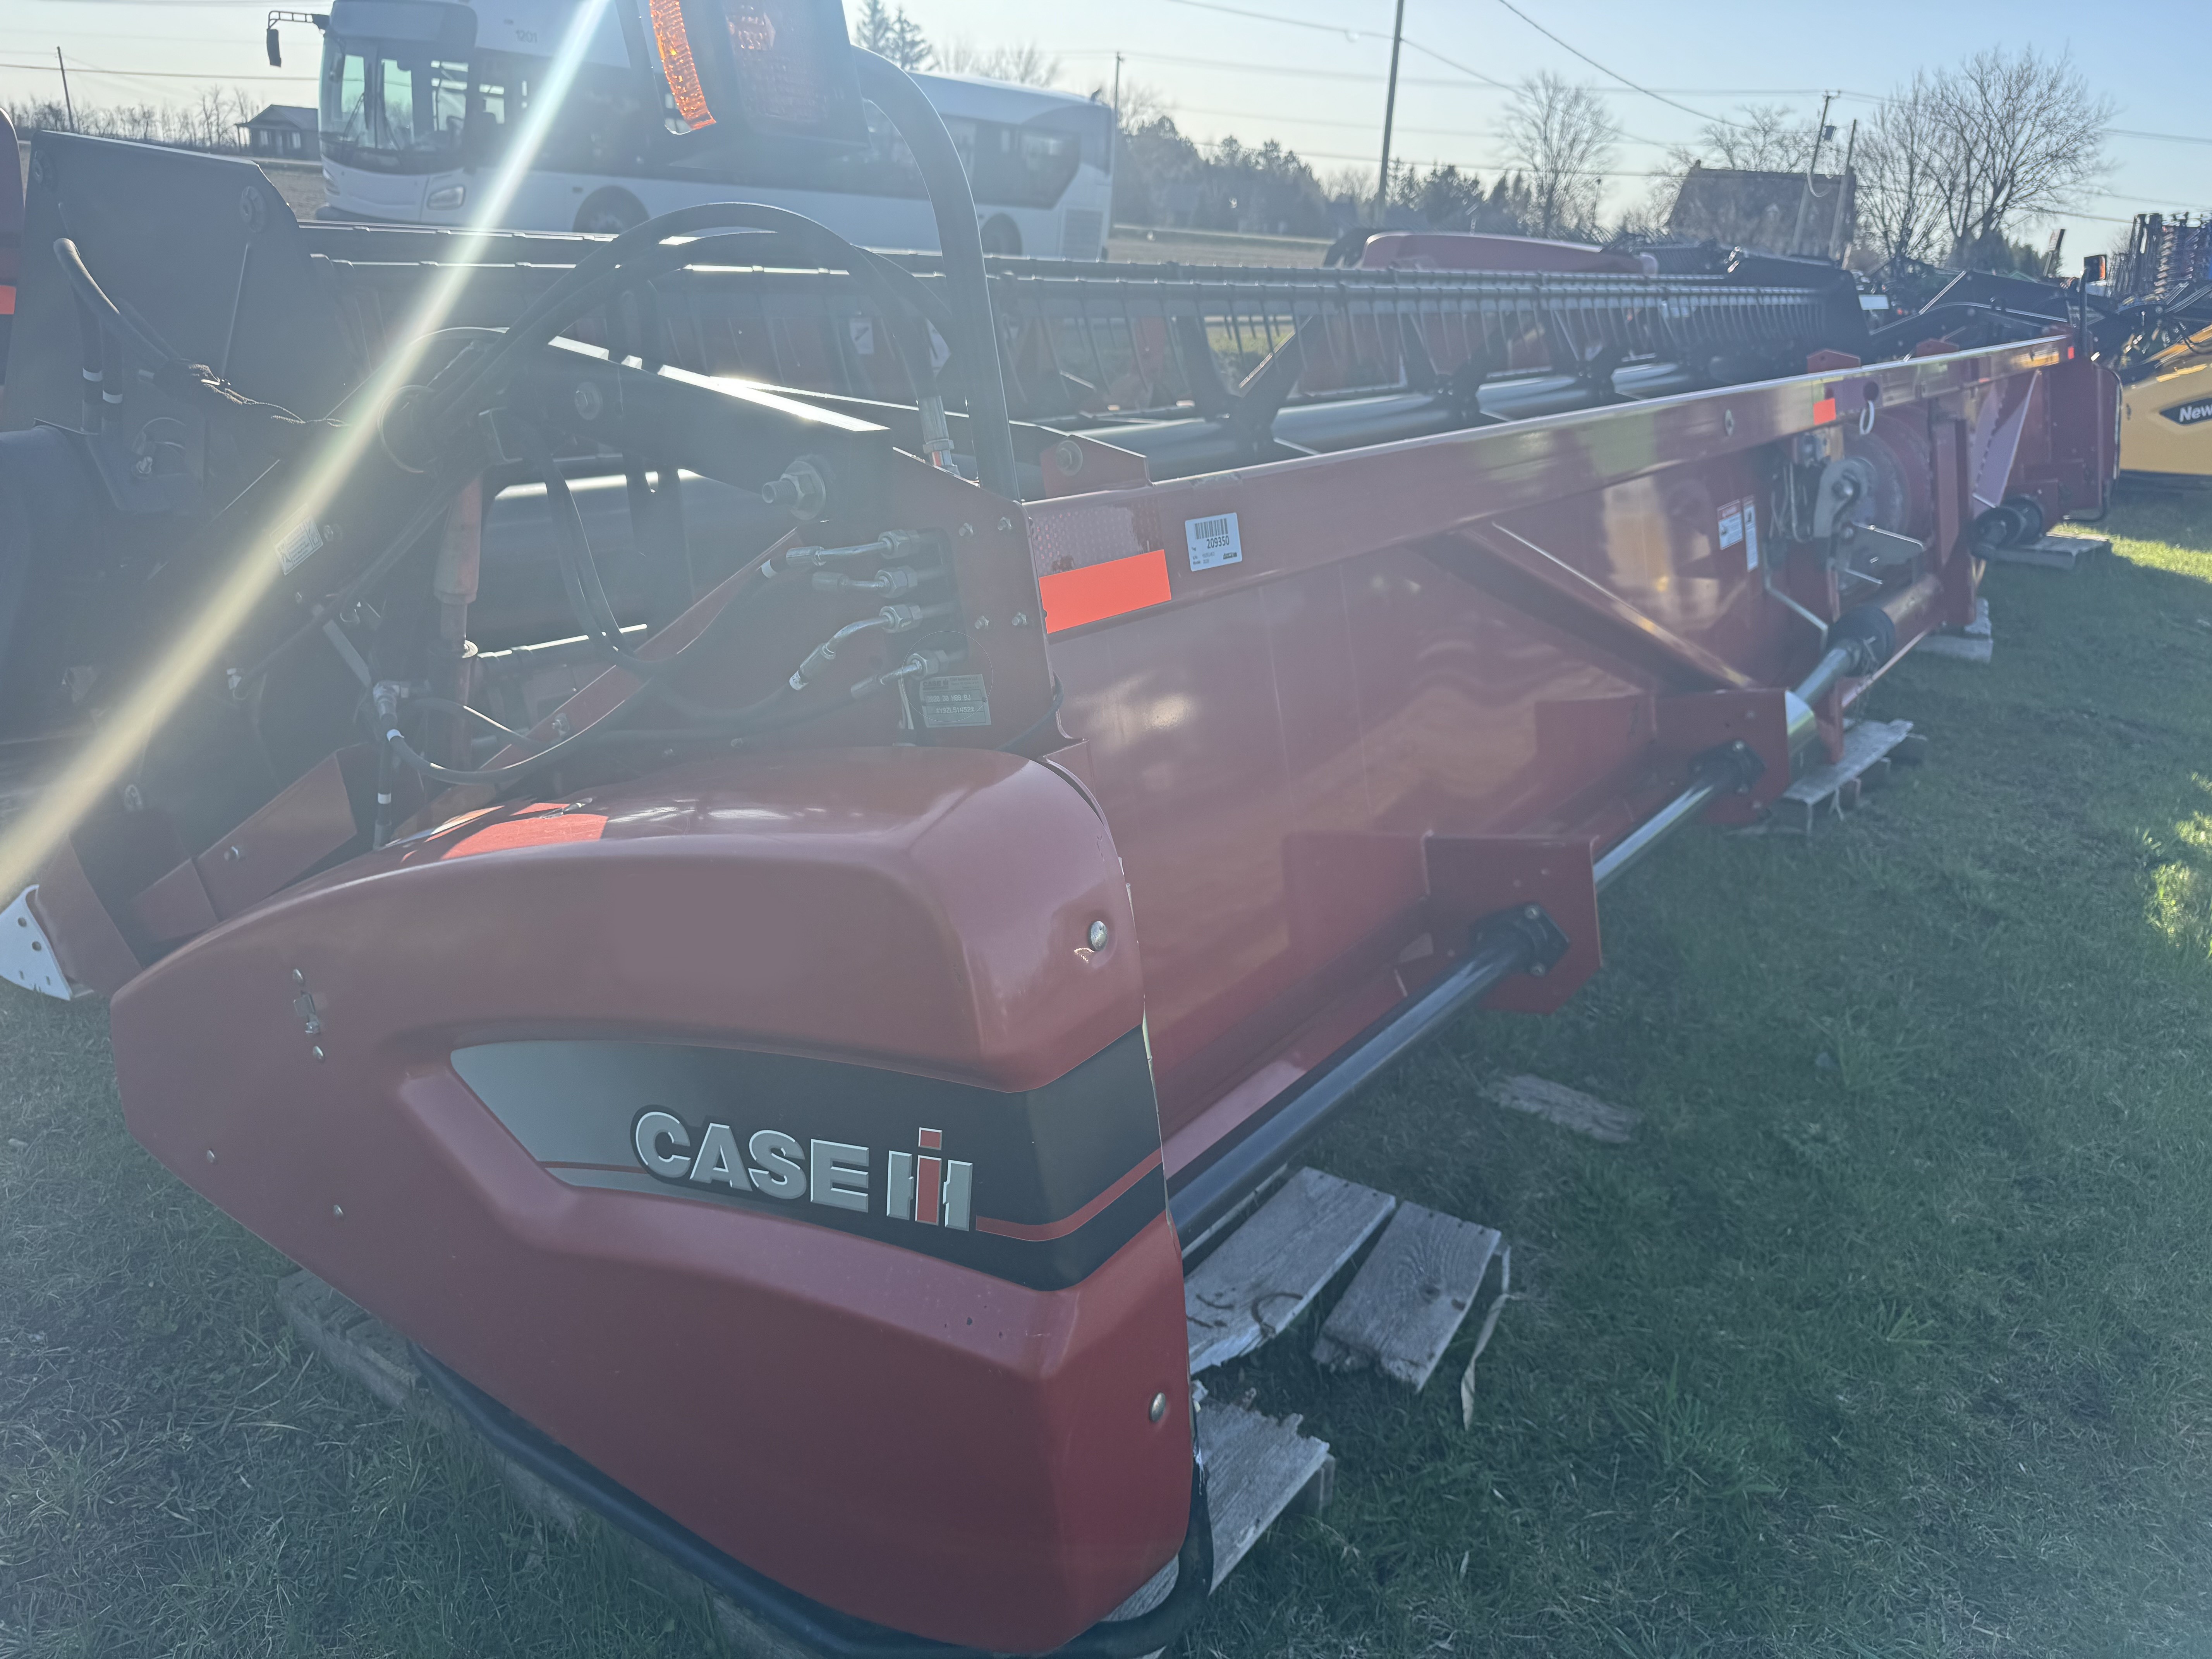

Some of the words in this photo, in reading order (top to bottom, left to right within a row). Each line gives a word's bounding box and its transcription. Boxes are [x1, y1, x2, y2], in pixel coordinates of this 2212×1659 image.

[515, 29, 538, 43] 1201
[1206, 535, 1230, 549] 209350
[635, 1111, 869, 1212] CASE
